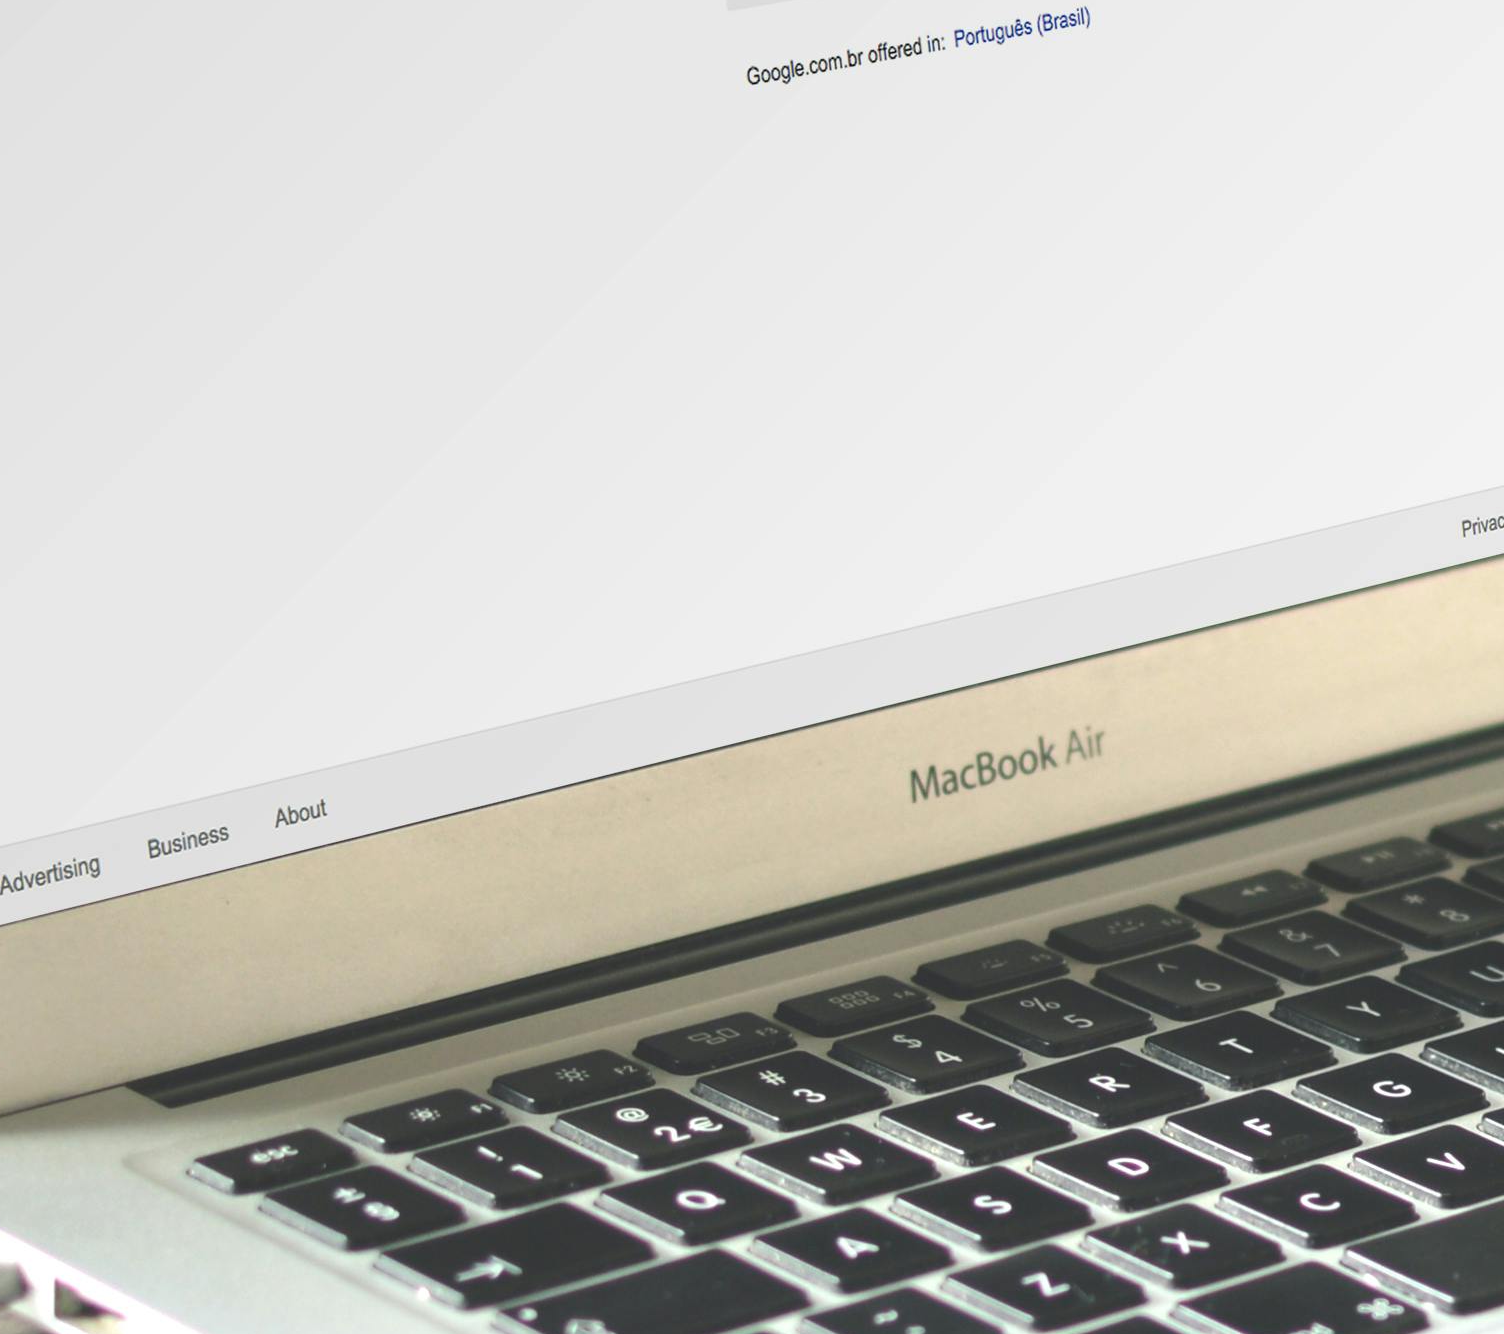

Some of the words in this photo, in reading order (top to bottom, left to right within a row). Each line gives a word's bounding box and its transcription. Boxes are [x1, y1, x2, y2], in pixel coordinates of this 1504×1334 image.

[747, 50, 863, 85] Google.com.br
[868, 37, 922, 63] offered
[927, 35, 945, 52] in:
[954, 19, 1032, 47] Português
[1037, 7, 1090, 36] (Brasil)
[910, 737, 1057, 803] MacBook
[1066, 726, 1105, 764] Air
[275, 799, 327, 828] About
[148, 827, 229, 859] Business
[0, 858, 100, 895] Advertising
[1440, 910, 1469, 921] 8
[1280, 930, 1310, 941] &
[1315, 944, 1340, 957] 7
[1196, 979, 1221, 991] 6
[1020, 998, 1060, 1011] %
[1347, 1002, 1380, 1016] Y
[1064, 1015, 1093, 1028] 5
[893, 1035, 922, 1048] $
[1219, 1038, 1253, 1053] T
[936, 1051, 962, 1063] 4
[760, 1071, 785, 1085] #
[1089, 1075, 1130, 1092] R
[793, 1089, 826, 1102] 3
[1373, 1081, 1411, 1097] G
[616, 1108, 651, 1122] @
[957, 1112, 996, 1130] E
[654, 1125, 691, 1143] 2
[688, 1116, 724, 1133] €
[1243, 1118, 1272, 1136] F
[810, 1149, 862, 1170] W
[1108, 1158, 1149, 1176] D
[1427, 1153, 1465, 1170] V
[512, 1164, 542, 1179] 1
[676, 1190, 726, 1210] Q
[974, 1195, 1012, 1214] S
[1300, 1193, 1340, 1211] C
[837, 1237, 879, 1258] A
[1161, 1231, 1209, 1254] X
[1023, 1273, 1069, 1296] Z
